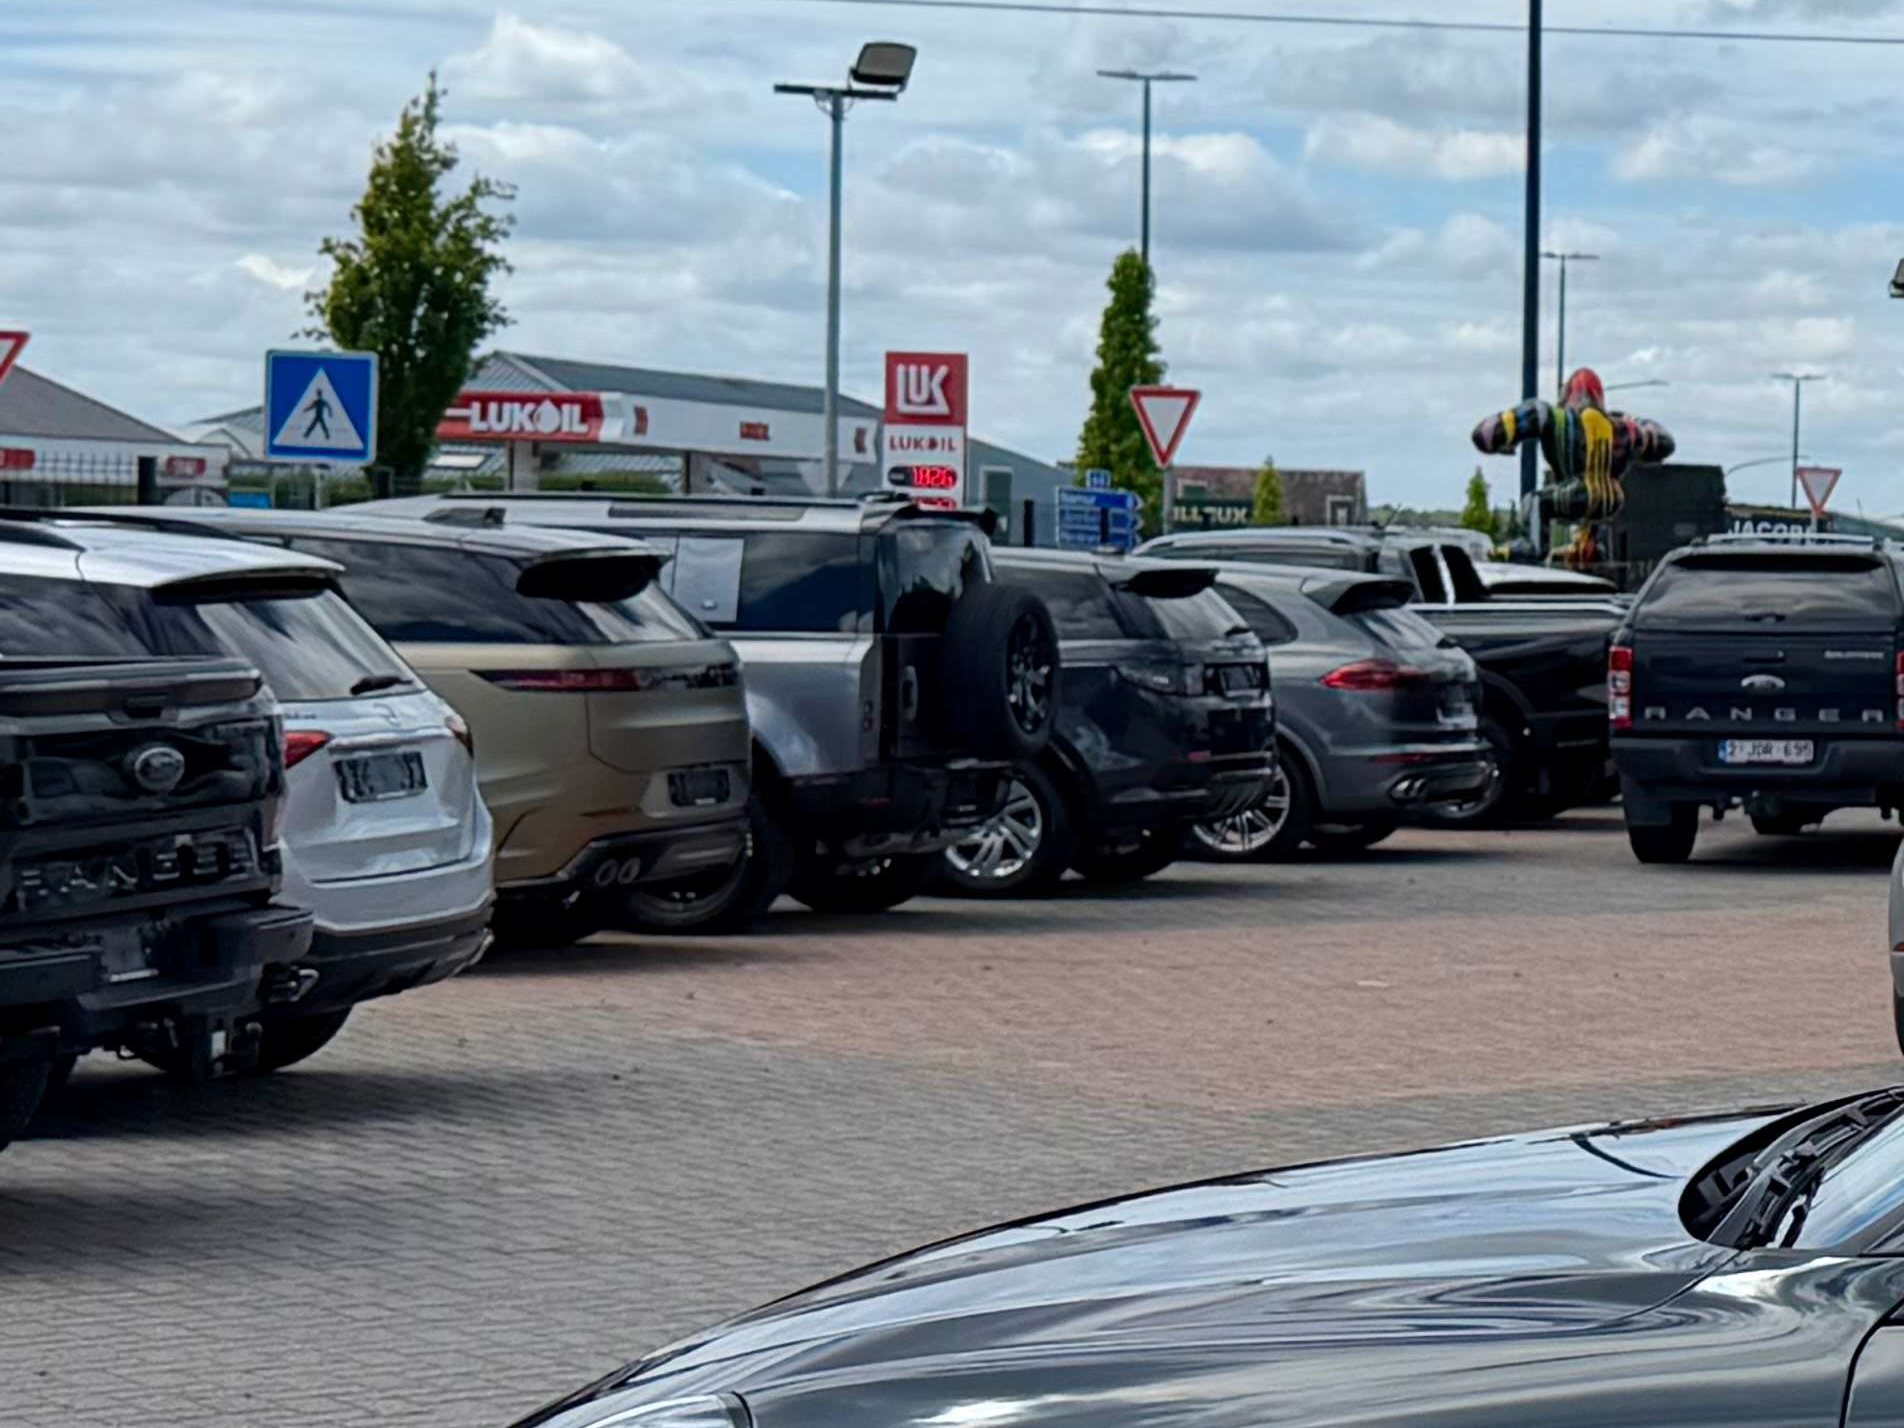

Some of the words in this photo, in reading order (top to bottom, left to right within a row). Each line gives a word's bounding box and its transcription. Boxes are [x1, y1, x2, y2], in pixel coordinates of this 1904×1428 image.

[469, 399, 589, 434] LUKOIL
[889, 434, 957, 452] LUKOIL
[1644, 706, 1884, 723] RANGER
